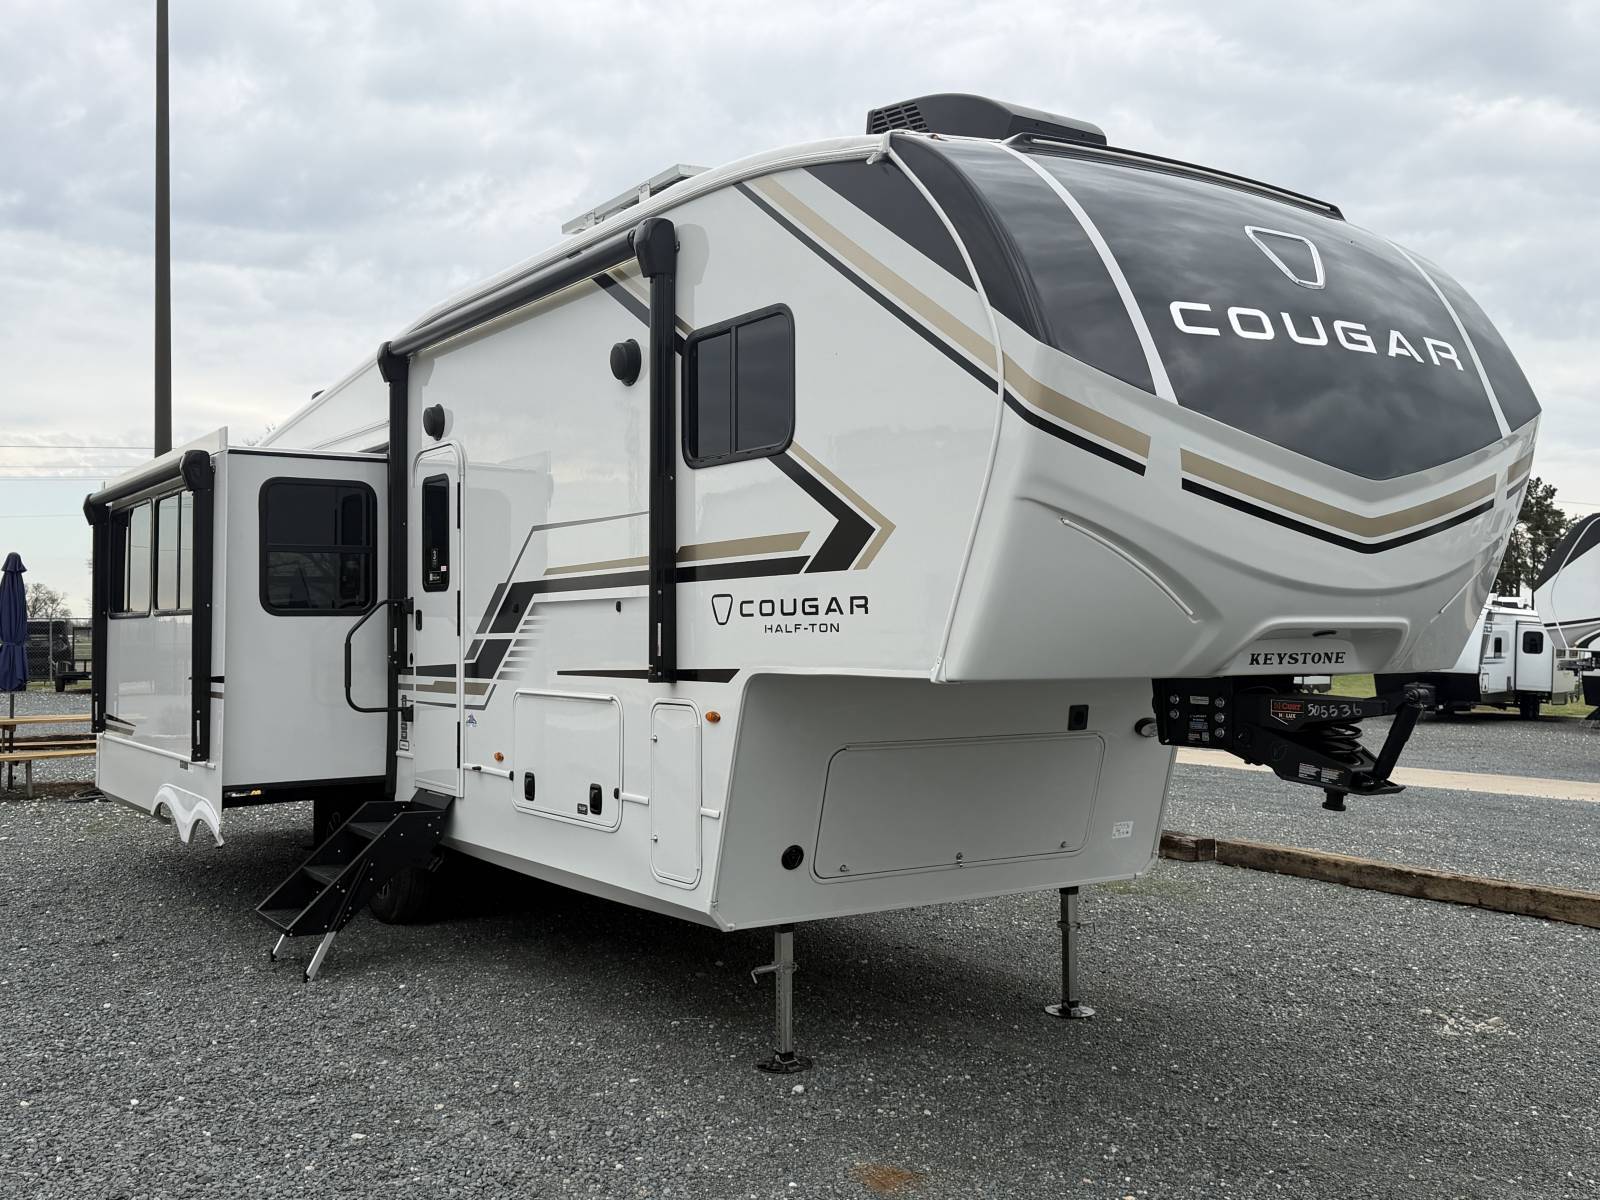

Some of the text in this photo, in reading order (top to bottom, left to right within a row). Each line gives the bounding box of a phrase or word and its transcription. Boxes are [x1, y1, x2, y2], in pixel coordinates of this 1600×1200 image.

[1169, 301, 1464, 371] COUGAR
[739, 595, 869, 617] COUGAR
[764, 623, 840, 633] HALF-TON
[1249, 652, 1346, 665] KEYSTONE
[1307, 703, 1362, 718] 505536
